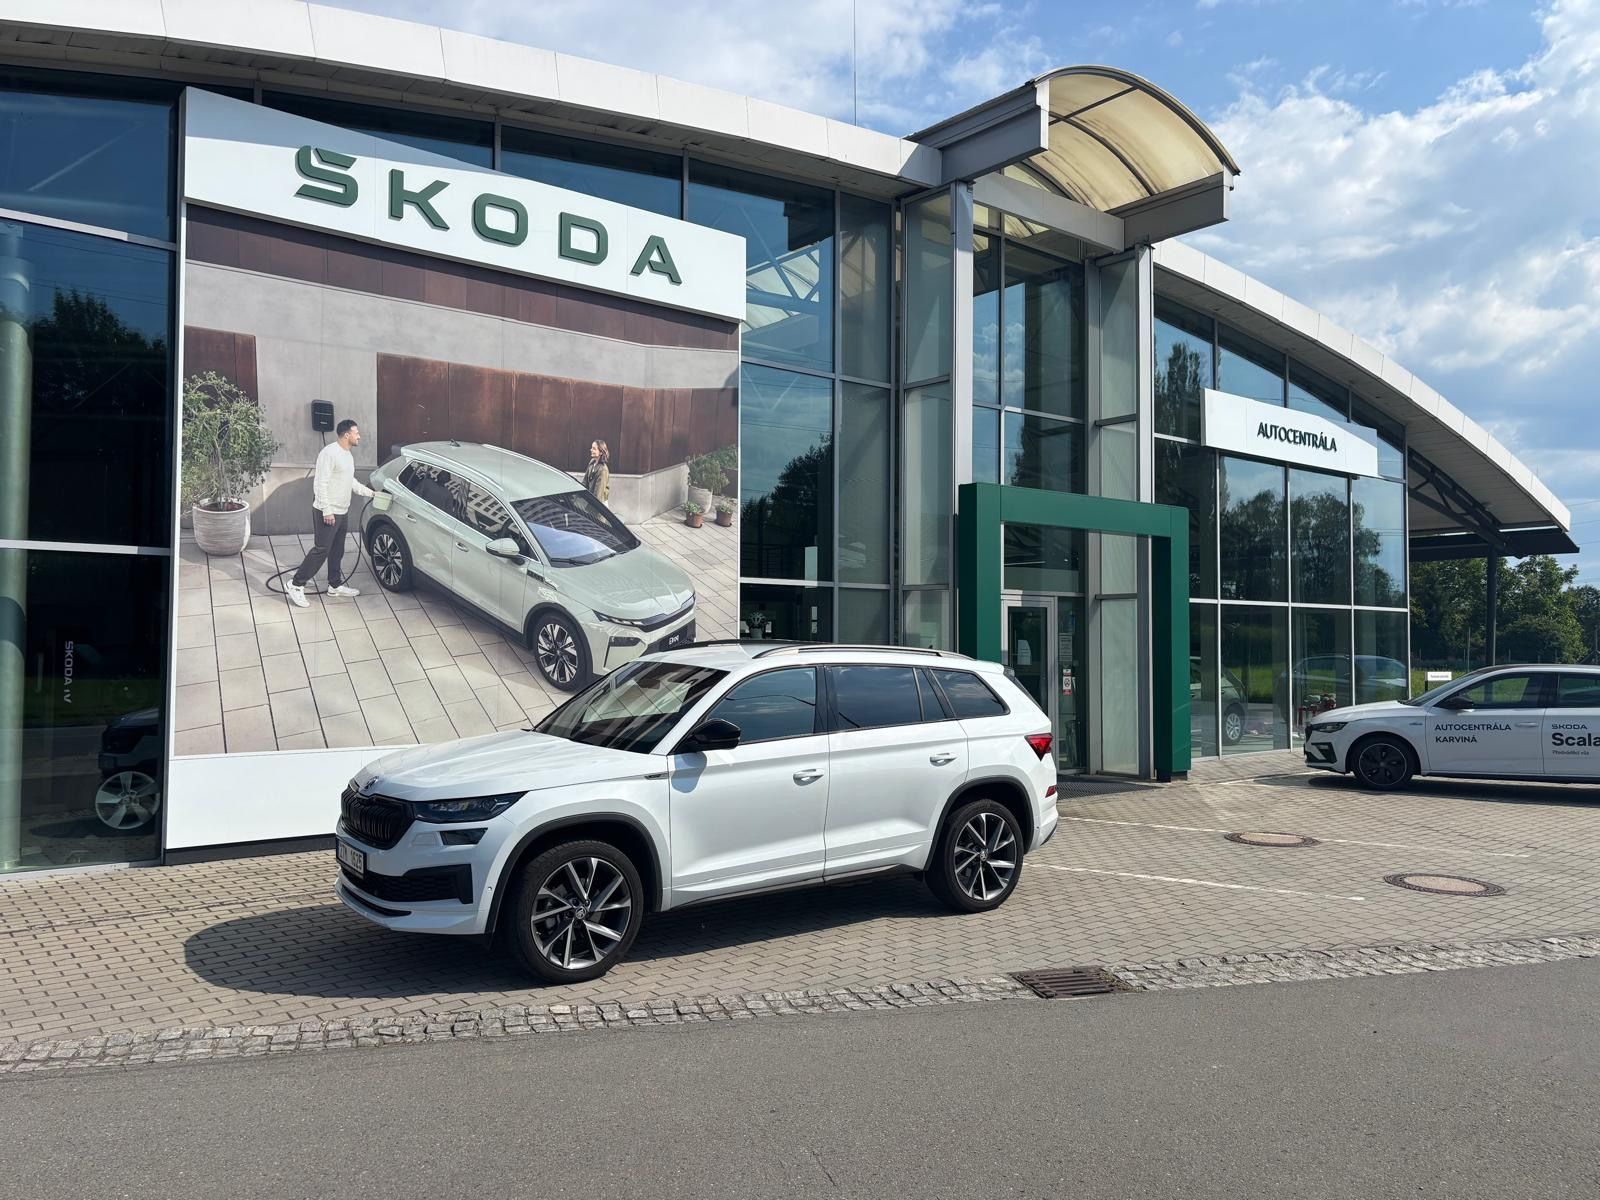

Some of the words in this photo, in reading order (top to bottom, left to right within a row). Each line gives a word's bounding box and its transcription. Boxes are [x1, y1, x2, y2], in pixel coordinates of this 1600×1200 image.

[1257, 422, 1337, 452] AUTOCENTRÁLA
[1435, 722, 1512, 731] AUTOCENTRÁLA
[1435, 735, 1478, 743] KARVINÁ
[1552, 733, 1600, 747] Scala
